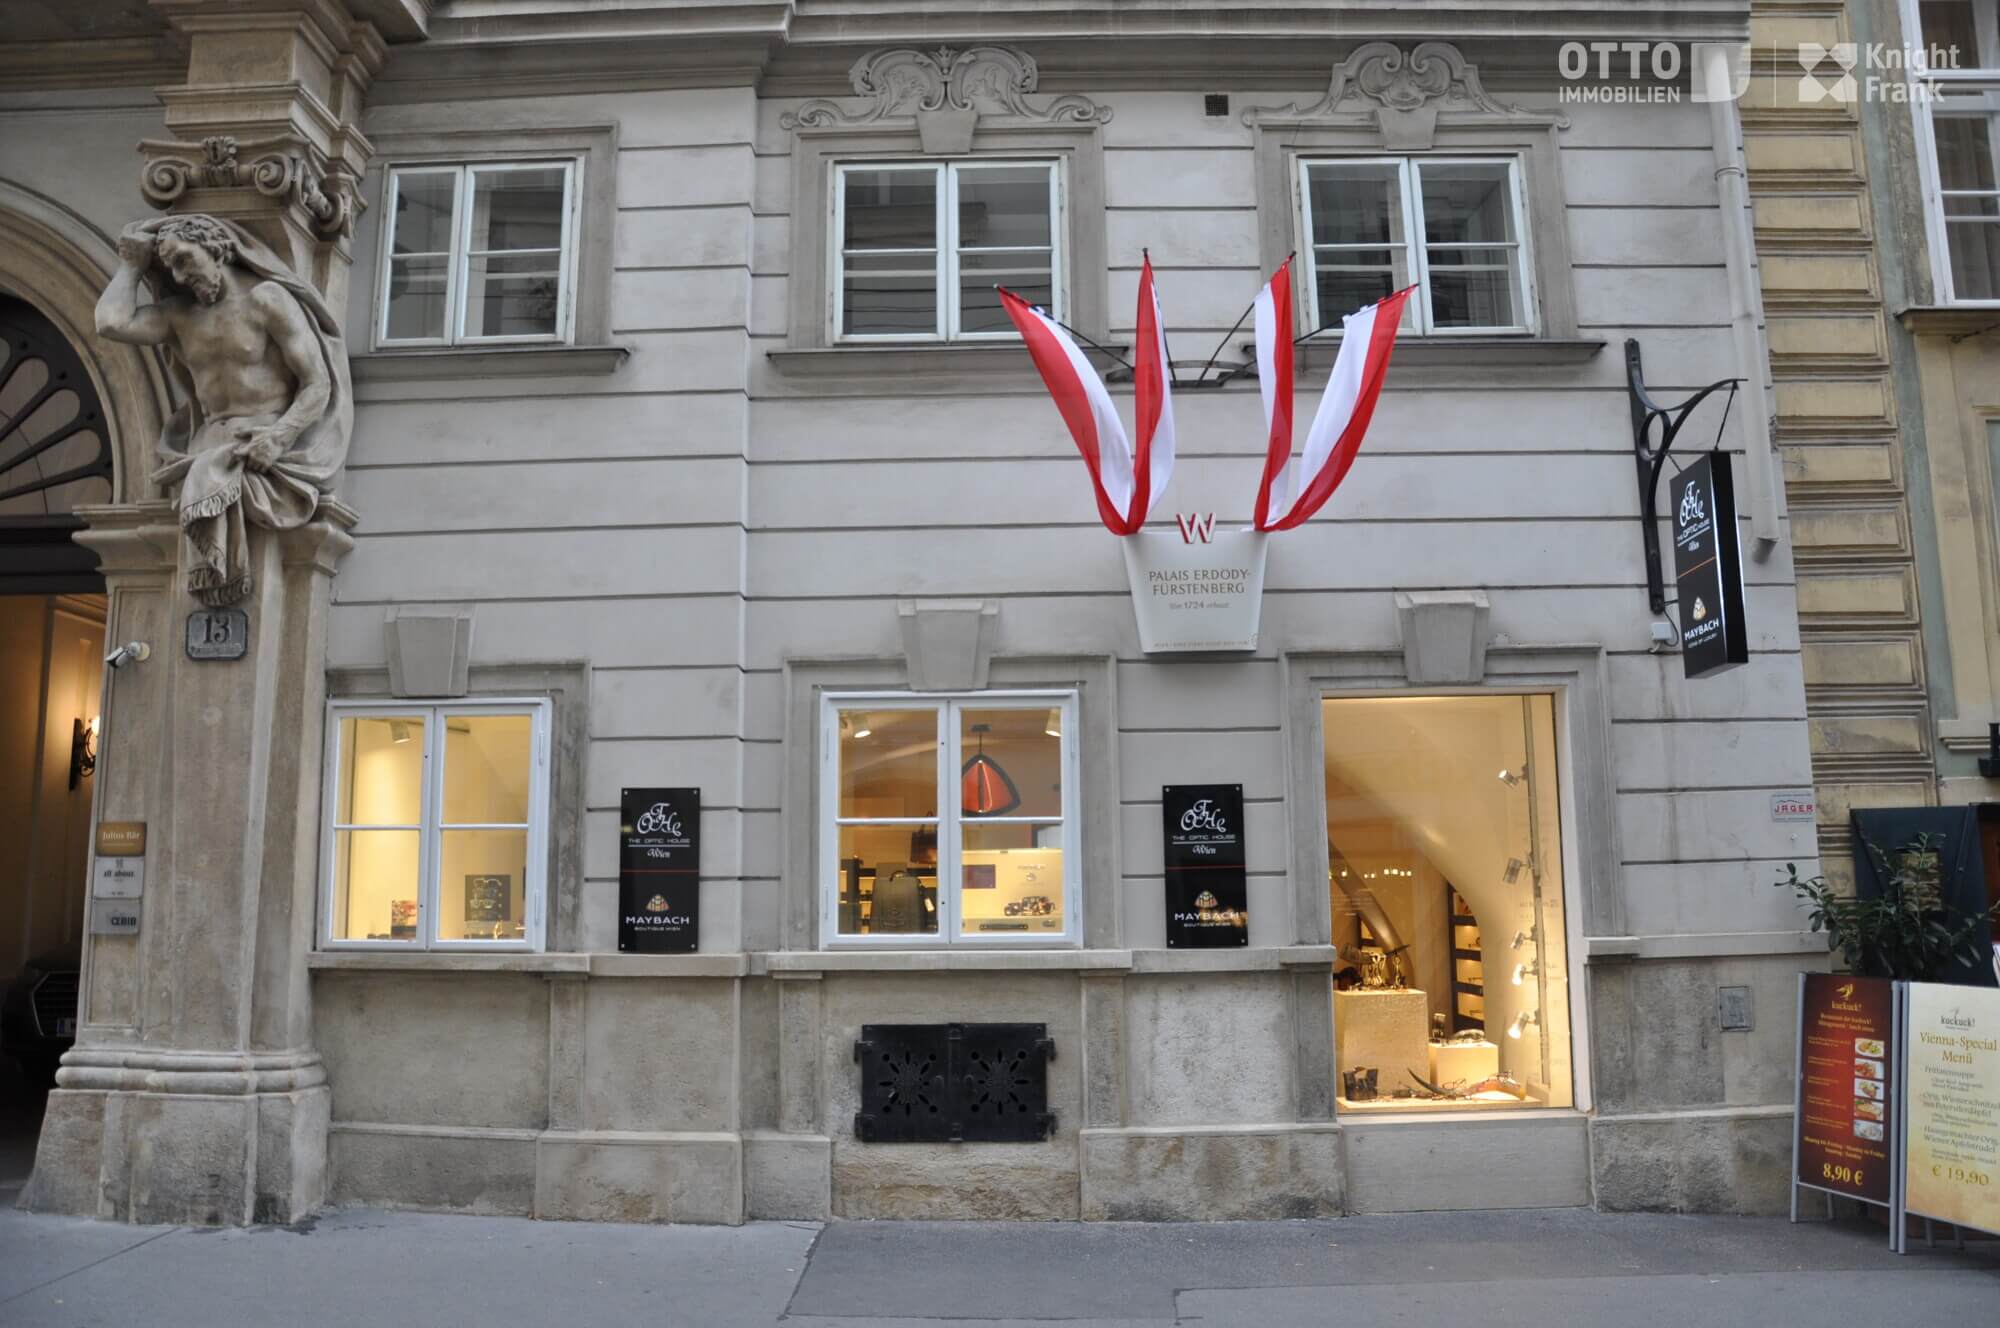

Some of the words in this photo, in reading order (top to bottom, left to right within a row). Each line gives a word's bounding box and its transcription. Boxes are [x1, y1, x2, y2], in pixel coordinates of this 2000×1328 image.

[1176, 512, 1216, 544] W
[1149, 570, 1189, 582] PALAIS
[1152, 582, 1245, 596] FÜRSTENBERG
[203, 615, 231, 645] 13
[1684, 618, 1720, 641] MAYBACH
[625, 915, 690, 925] MAYBACH
[1174, 911, 1240, 921] MAYBACH
[1941, 1015, 1976, 1028] kuckuck!
[1919, 1031, 1998, 1052] Vienna-Special
[1941, 1050, 1973, 1065] Menü
[1823, 1163, 1851, 1183] 8,90
[1854, 1170, 1864, 1186] €
[1931, 1164, 1942, 1177] €
[1948, 1167, 1990, 1186] 19,90
